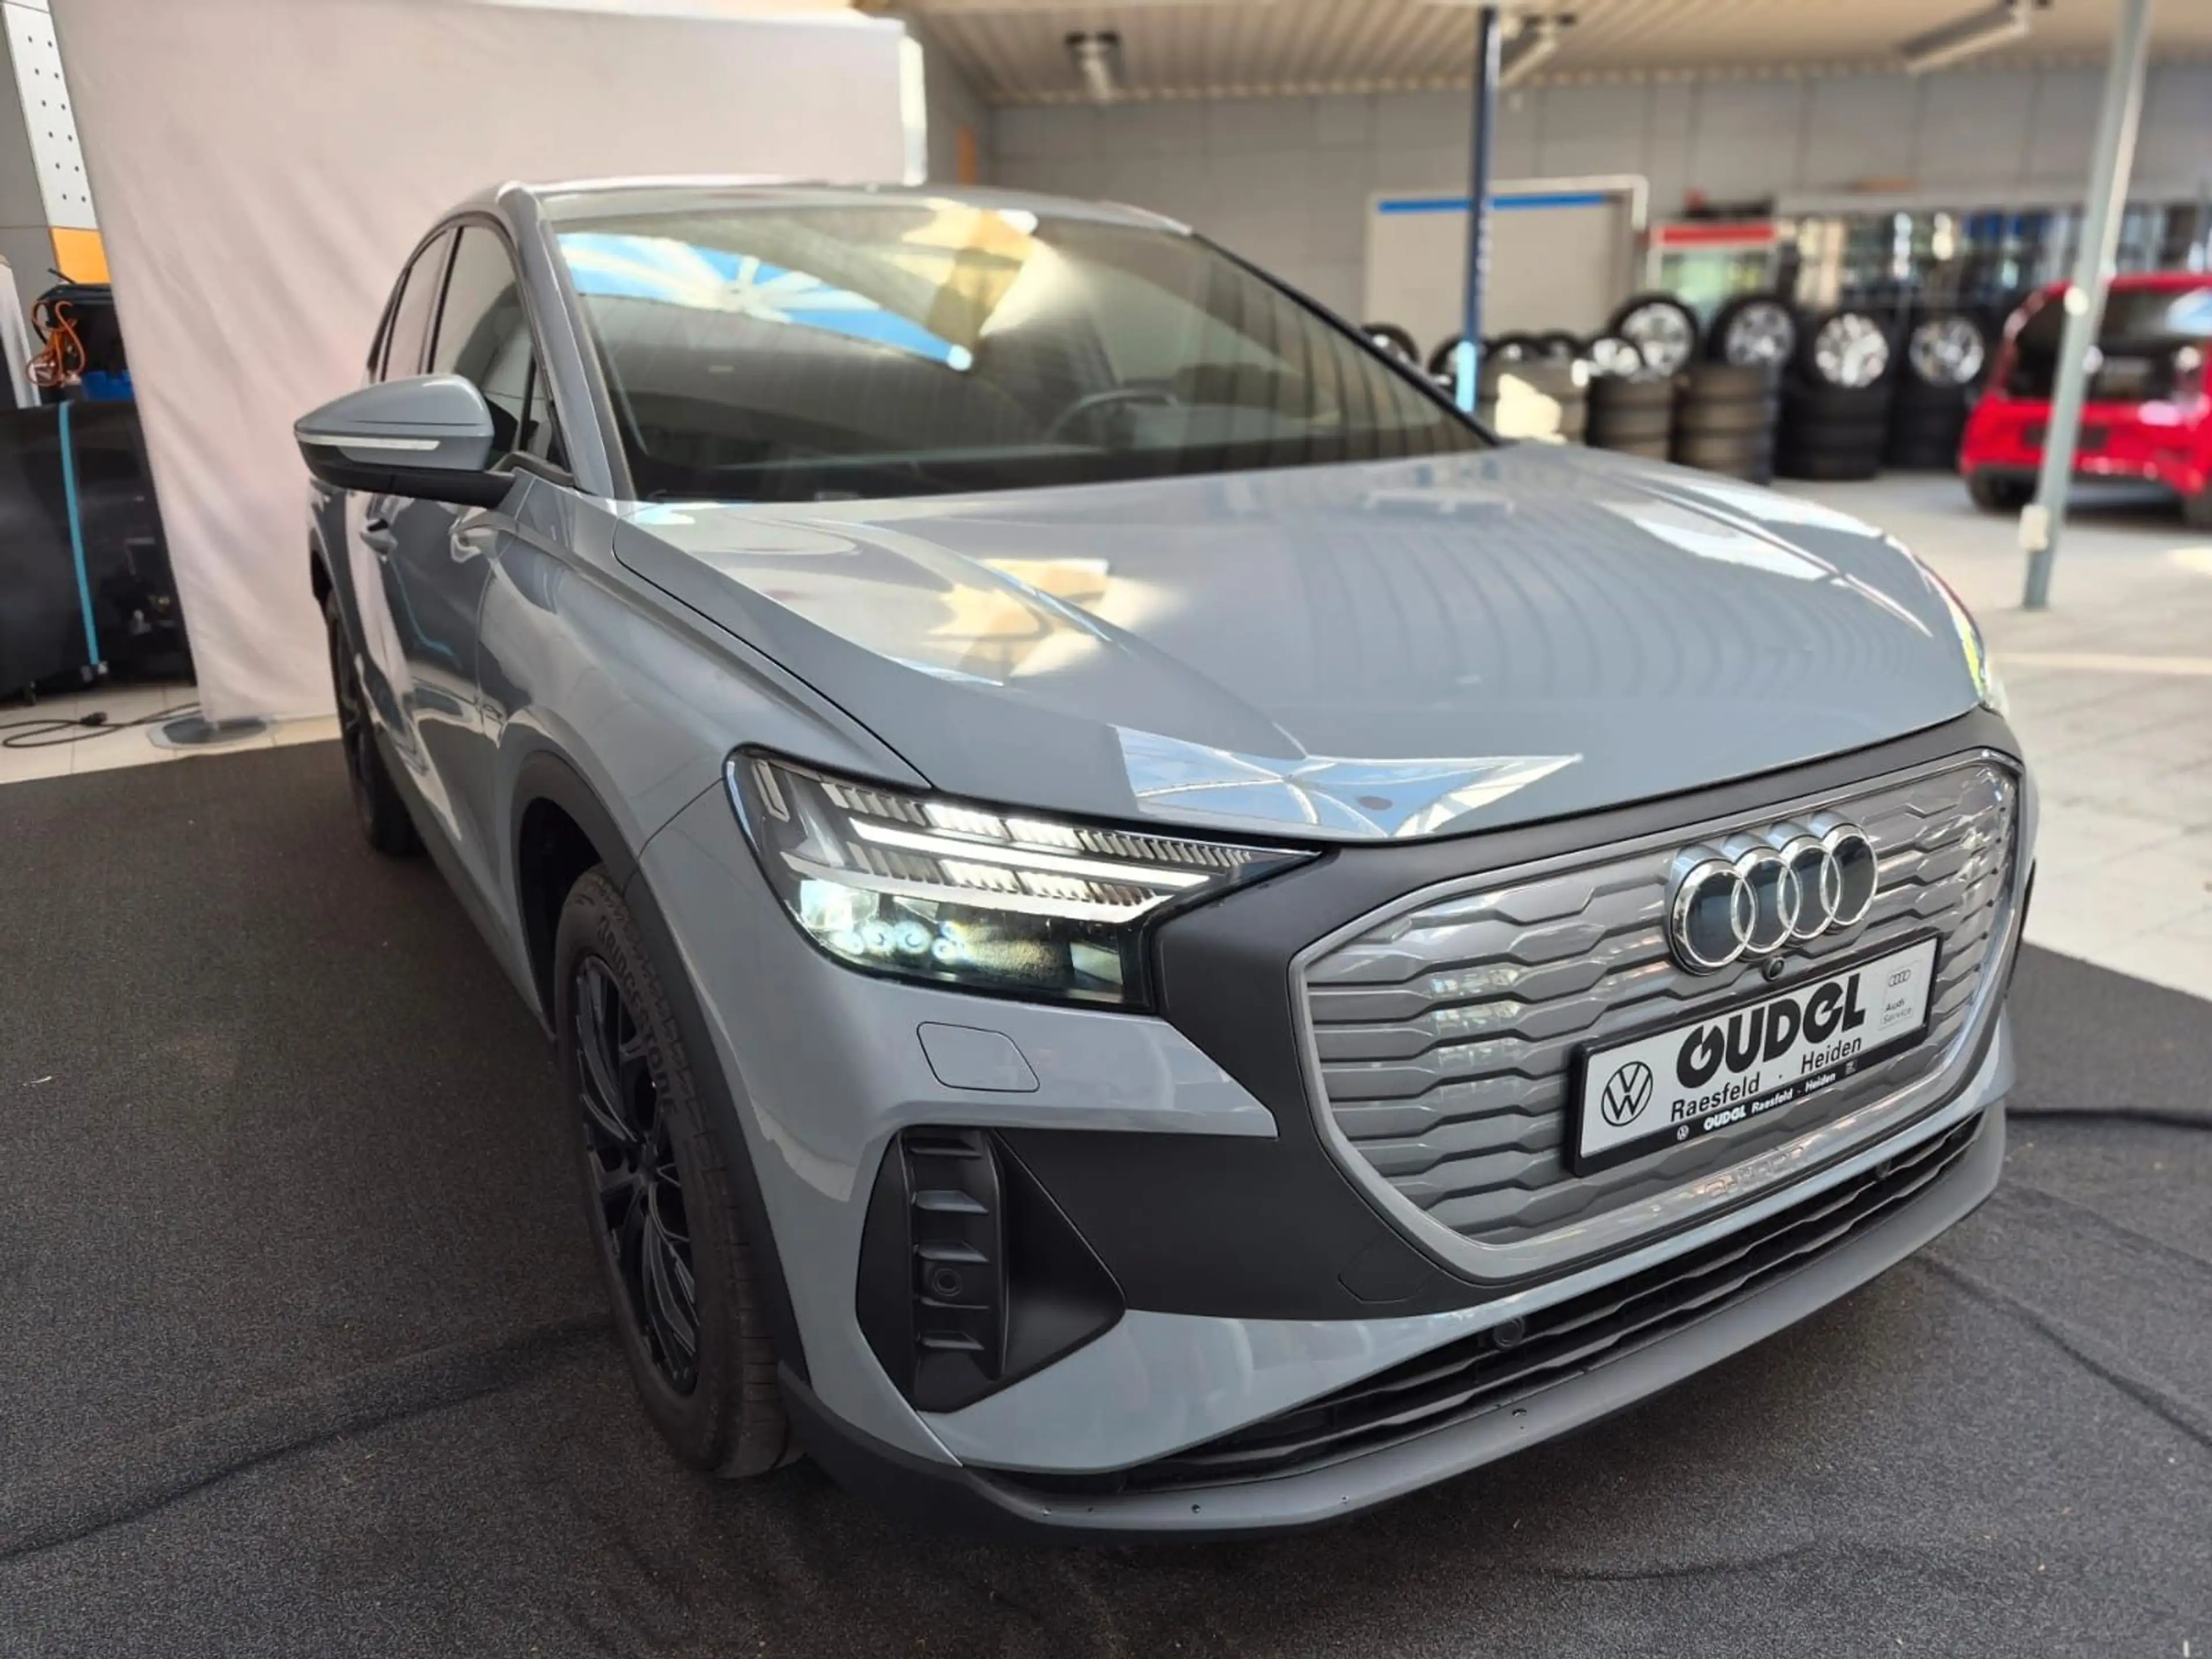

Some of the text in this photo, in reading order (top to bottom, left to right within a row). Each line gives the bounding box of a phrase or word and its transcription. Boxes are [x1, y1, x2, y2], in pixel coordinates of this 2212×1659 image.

[1671, 1037, 1862, 1123] Raesfeld Heiden
[1752, 1088, 1793, 1114] Raesfeld
[1805, 1073, 1836, 1093] Heiden
